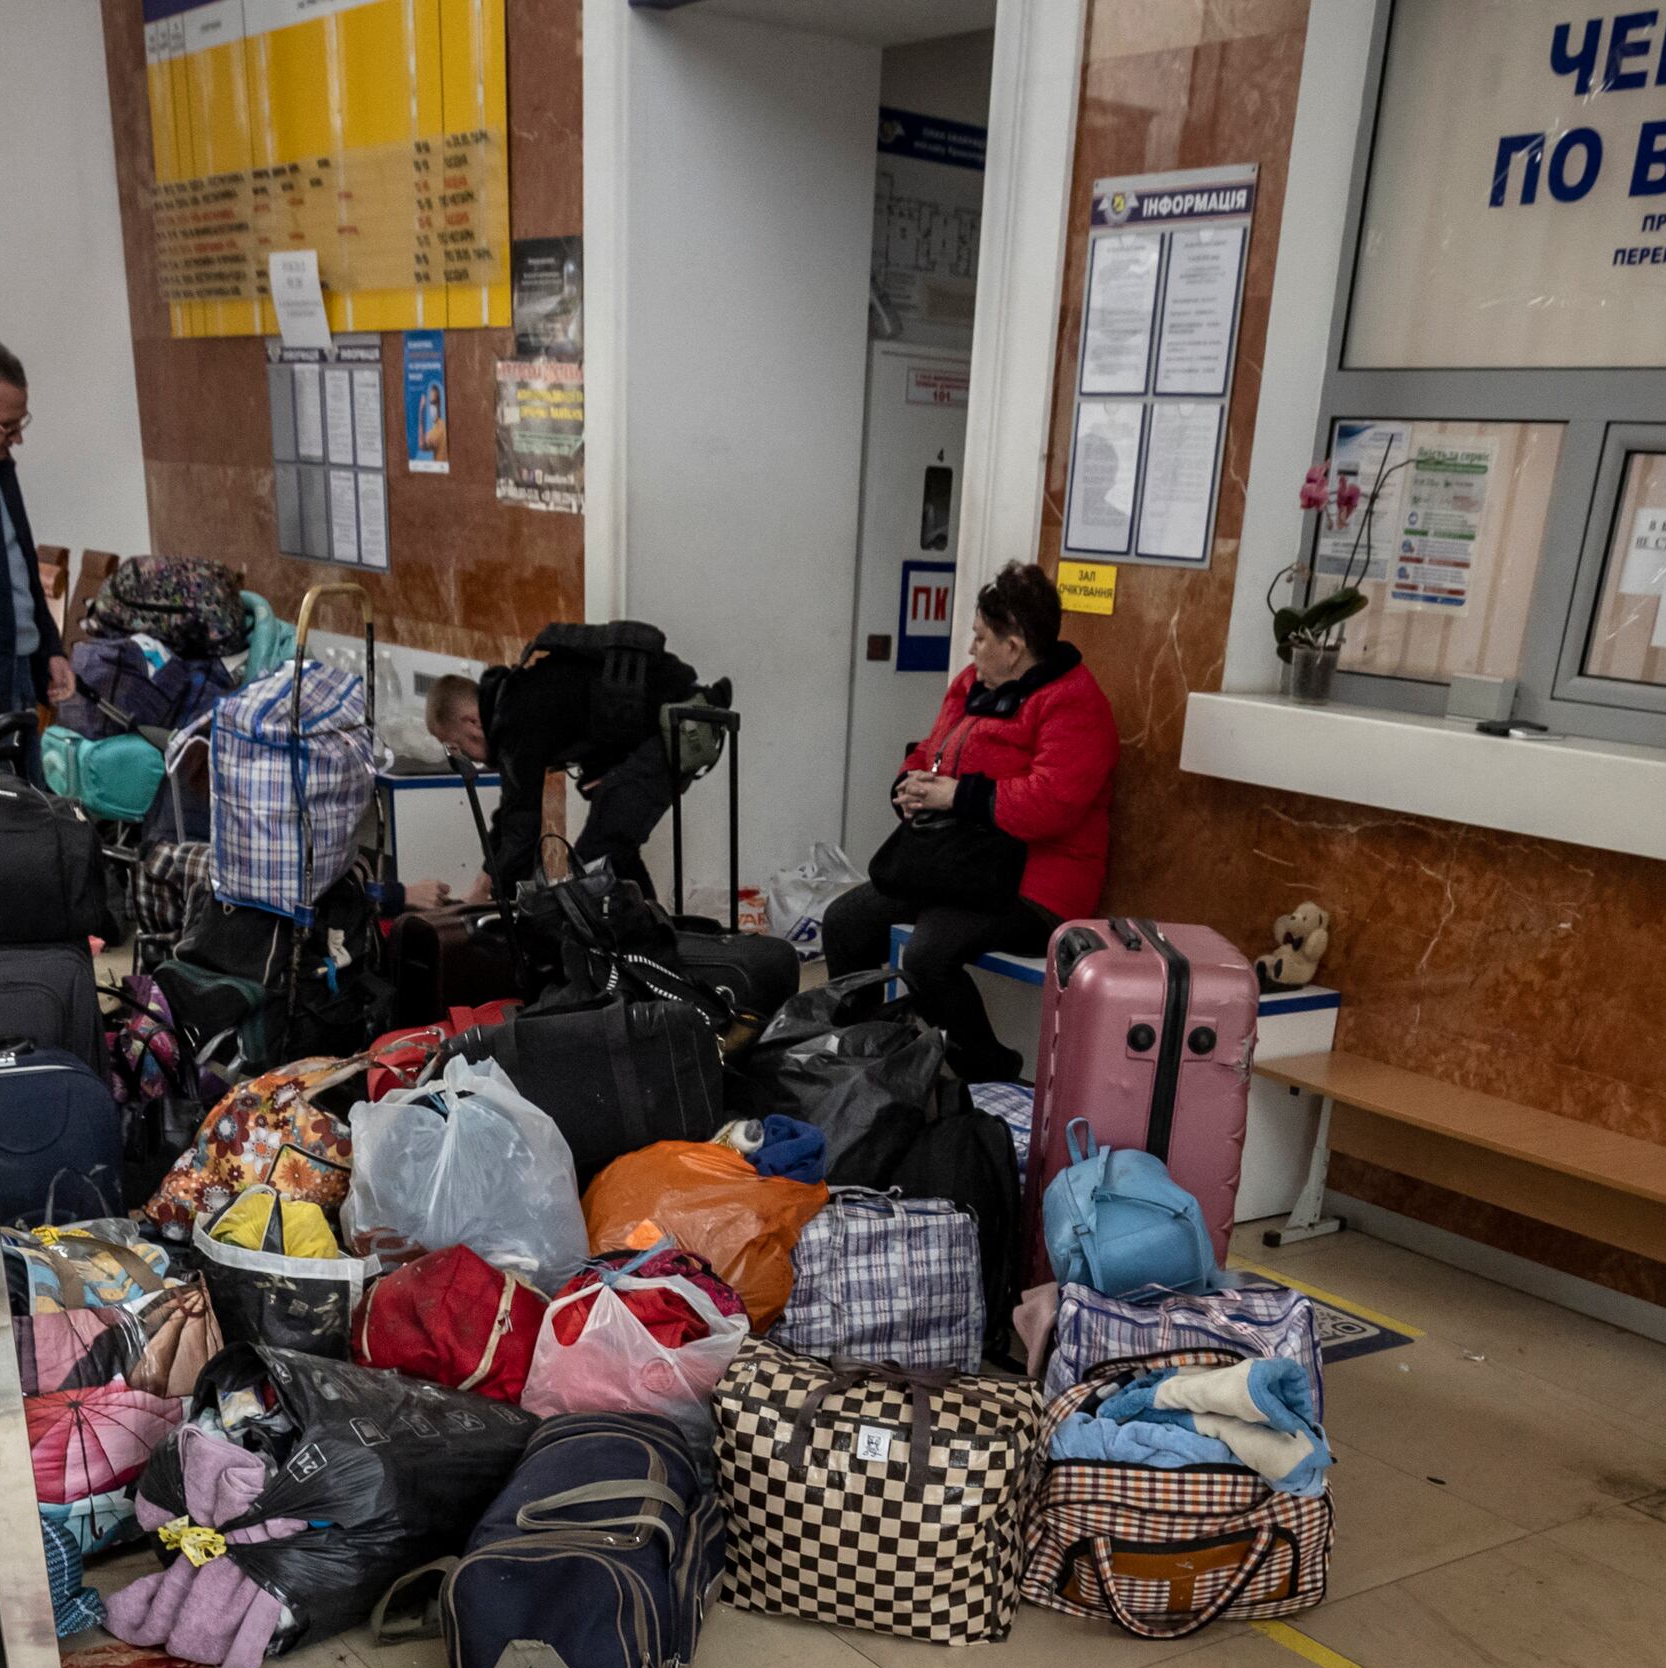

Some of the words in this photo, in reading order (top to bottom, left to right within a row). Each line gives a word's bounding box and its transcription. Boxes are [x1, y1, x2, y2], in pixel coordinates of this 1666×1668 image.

[1488, 126, 1603, 208] ПО
[1142, 188, 1248, 218] ІНФОРМАЦІЯ
[1078, 569, 1096, 582] ЗАЛ
[911, 586, 949, 621] ПК
